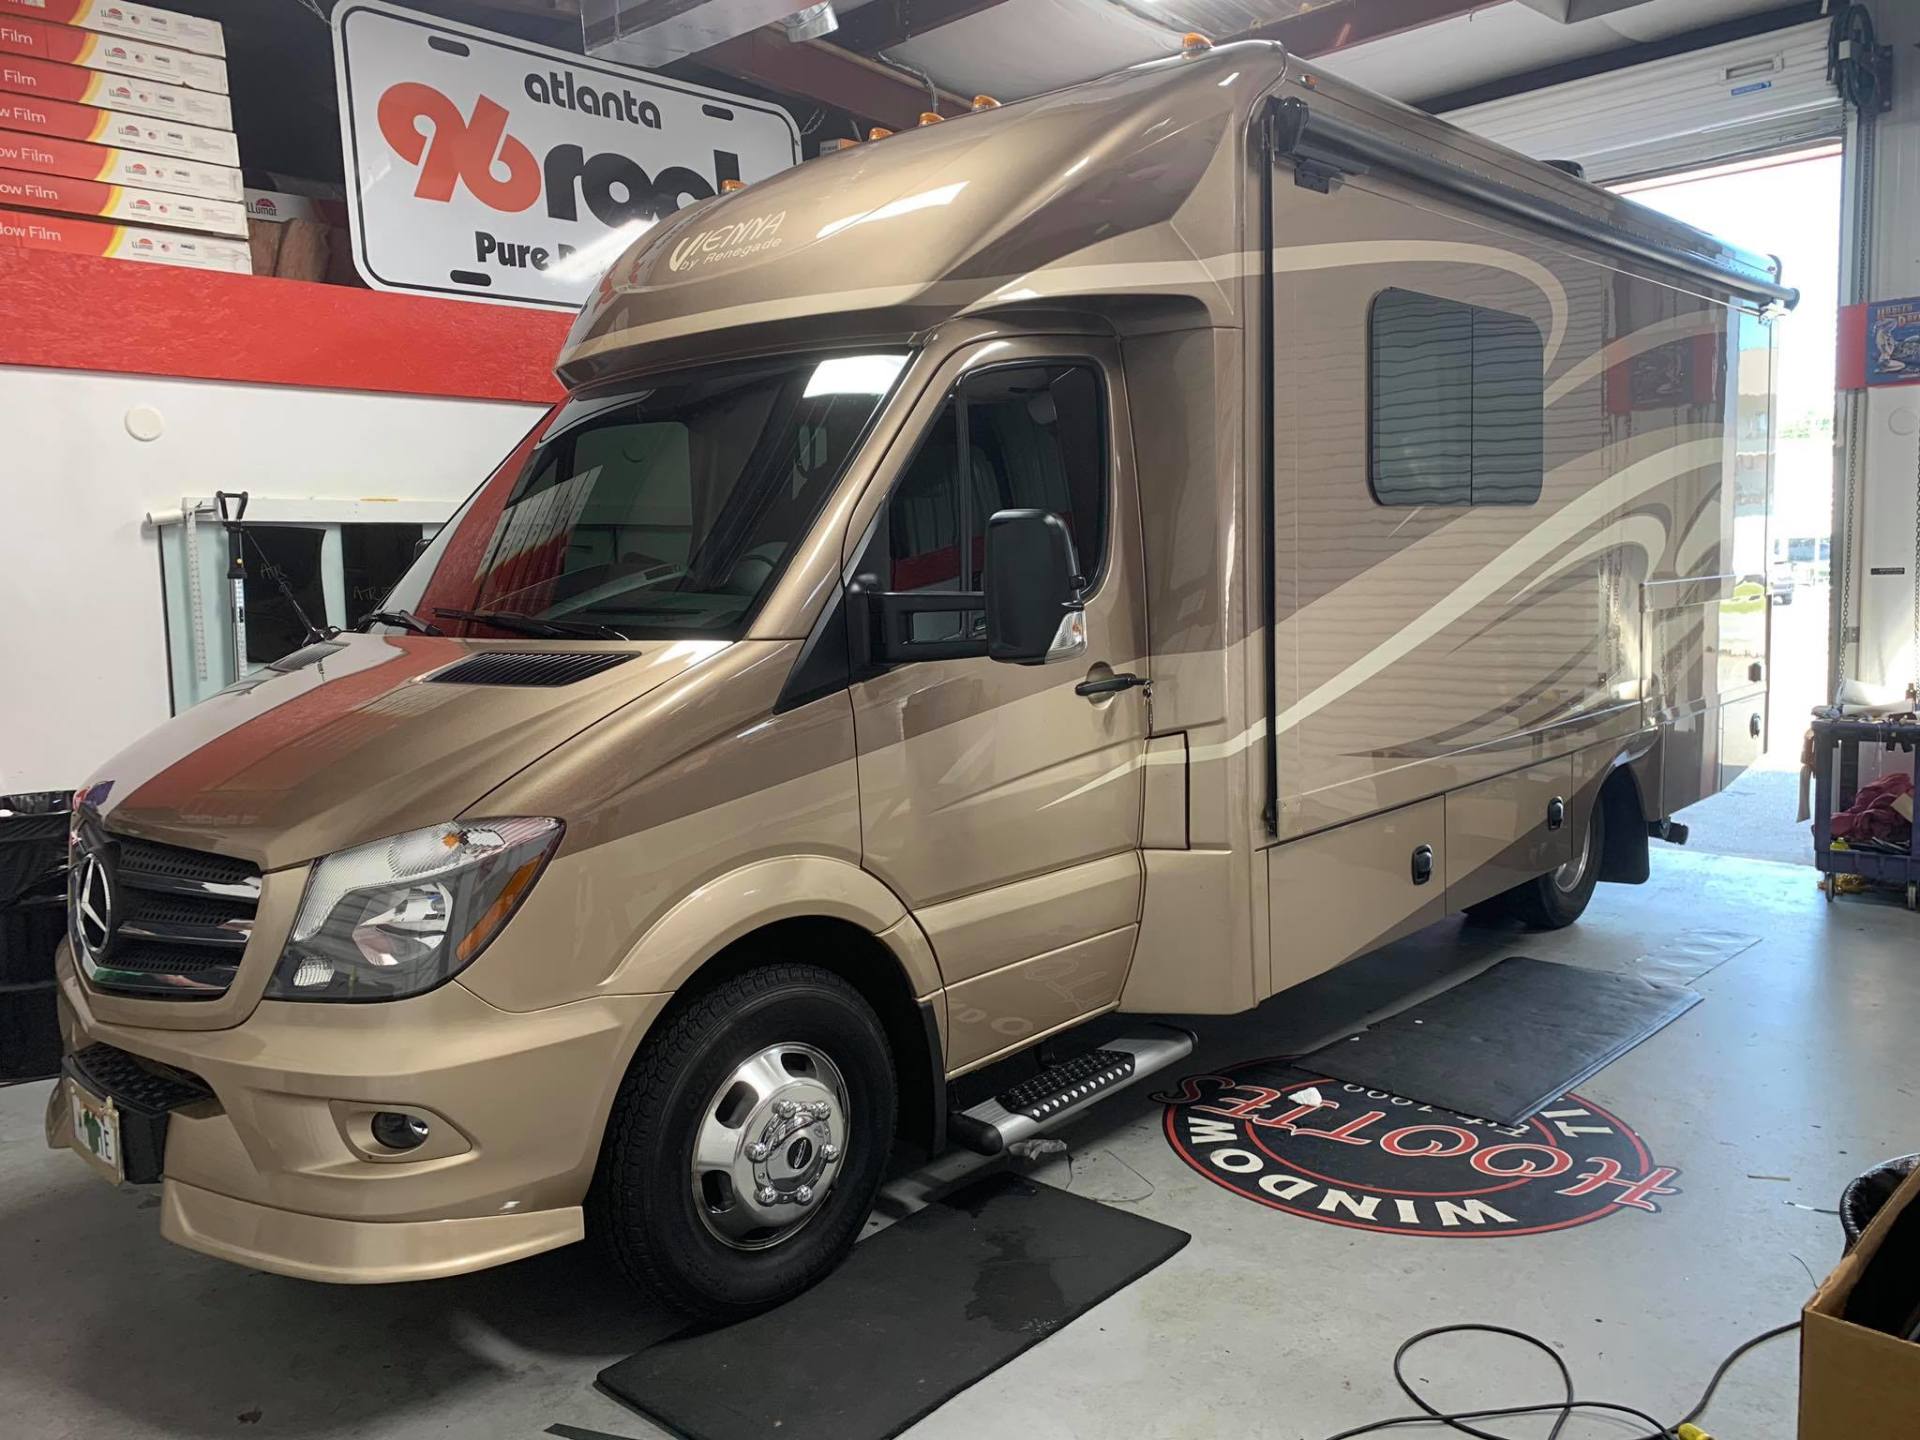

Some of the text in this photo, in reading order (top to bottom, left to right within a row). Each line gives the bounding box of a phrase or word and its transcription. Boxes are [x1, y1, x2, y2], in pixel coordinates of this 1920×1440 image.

[0, 27, 33, 45] Film
[3, 69, 37, 87] Film
[524, 71, 662, 130] atlanta
[13, 107, 46, 124] Film
[21, 147, 54, 164] Film
[25, 184, 58, 200] Film
[29, 225, 62, 242] Film
[668, 210, 786, 272] VIENNA
[474, 230, 550, 271] Pure
[679, 237, 783, 271] by Renegade
[1187, 1116, 1519, 1228] WINDOW
